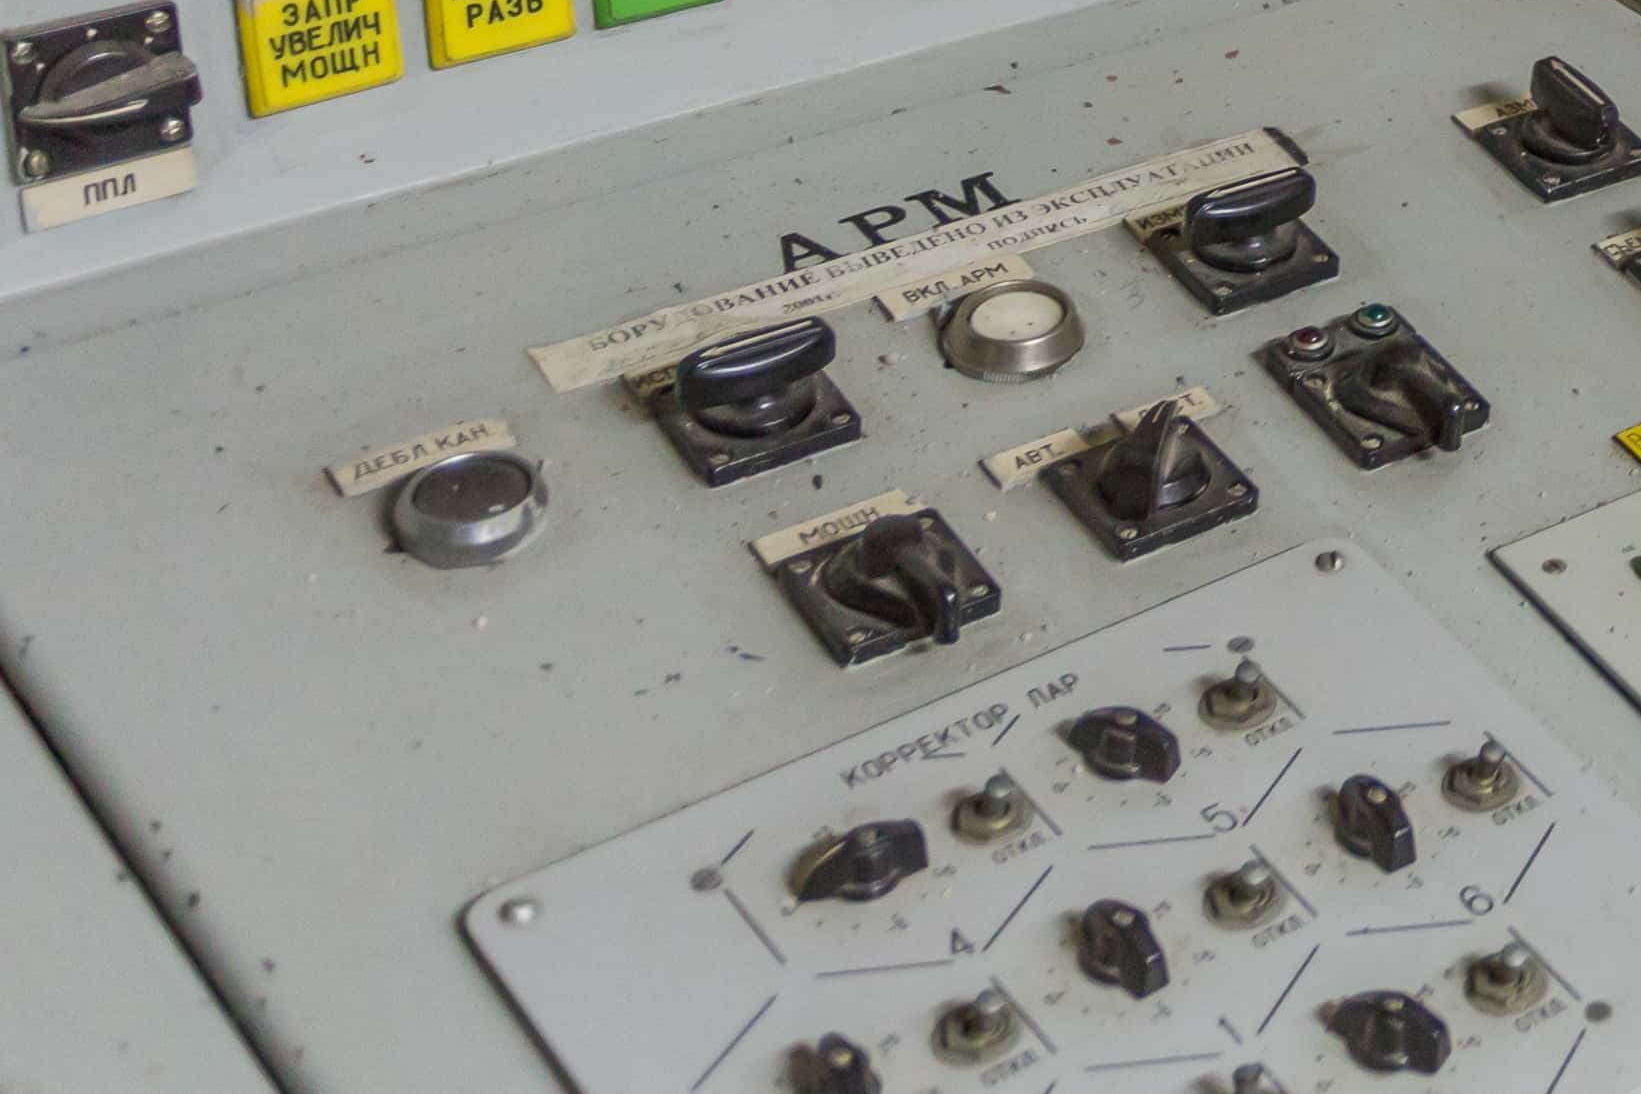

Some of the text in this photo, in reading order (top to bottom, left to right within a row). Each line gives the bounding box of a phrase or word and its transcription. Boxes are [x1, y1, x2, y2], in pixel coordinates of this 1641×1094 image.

[268, 12, 383, 62] УВЕЛИЧ
[281, 45, 383, 89] МОЩН
[82, 172, 137, 207] ППЛ
[775, 169, 1023, 277] АРМ
[824, 224, 988, 280] ВЫВЕДЕНО
[992, 208, 1029, 231] ИЗ
[839, 672, 1080, 789] КОРРЕКТОР ПАР
[1200, 803, 1239, 834] 5
[1458, 883, 1496, 917] 6
